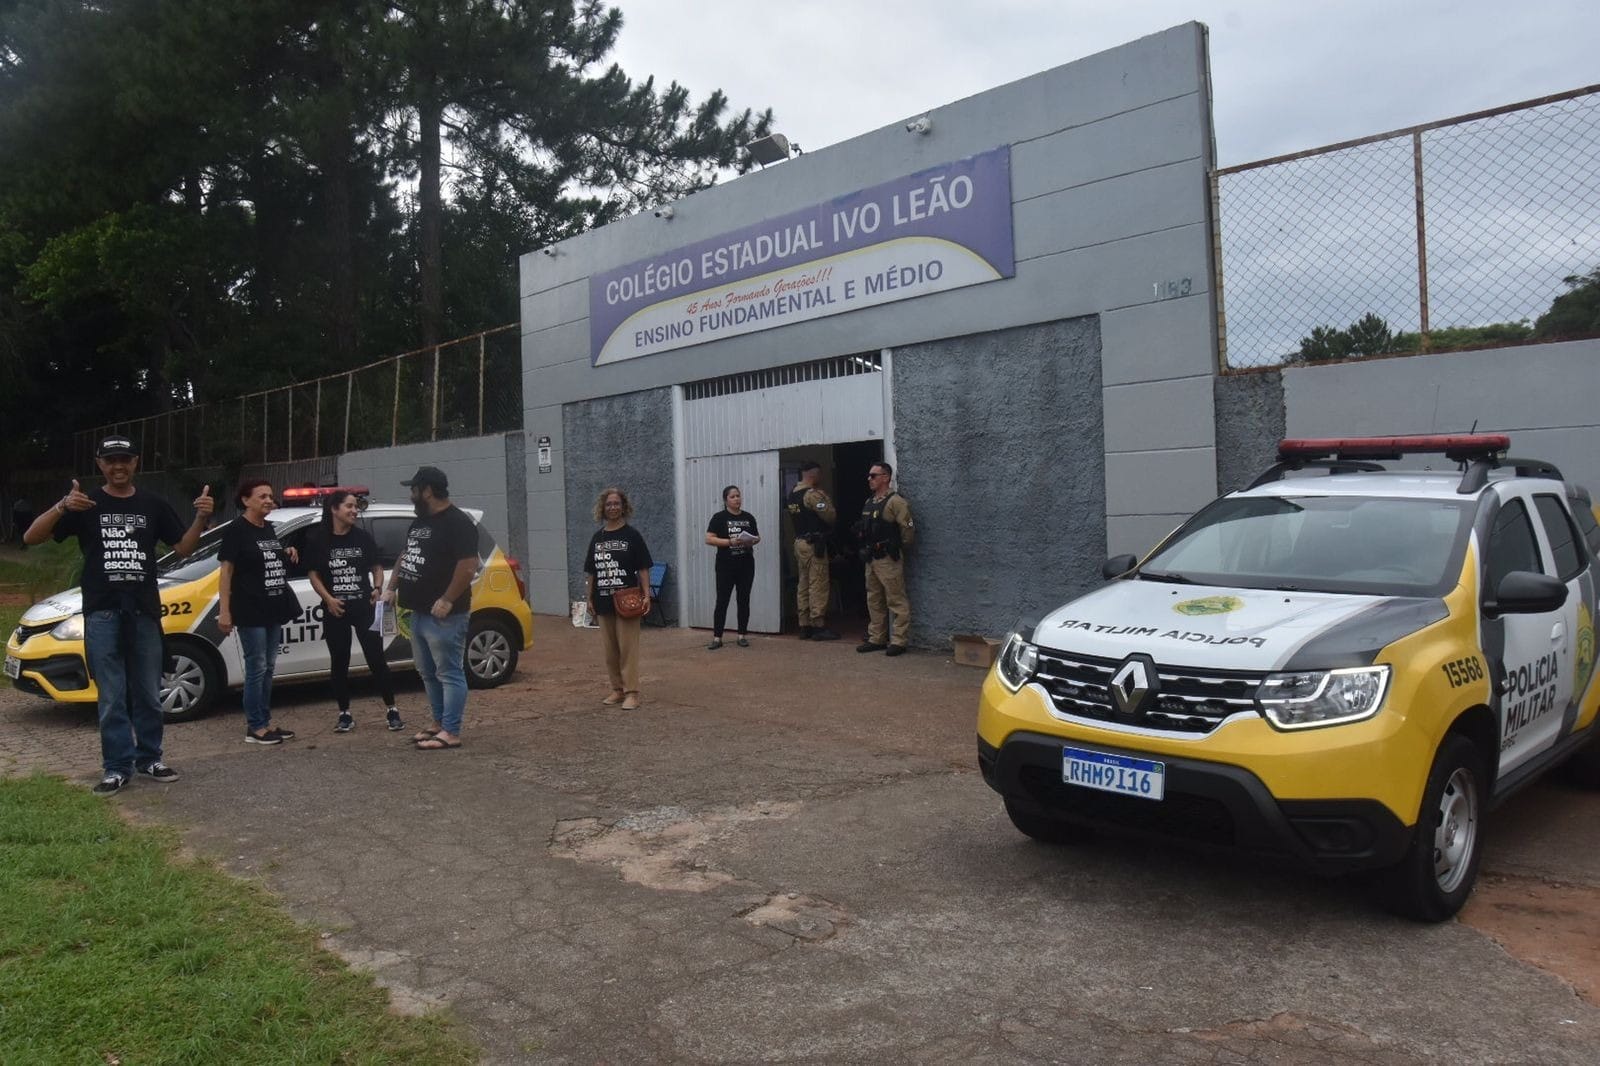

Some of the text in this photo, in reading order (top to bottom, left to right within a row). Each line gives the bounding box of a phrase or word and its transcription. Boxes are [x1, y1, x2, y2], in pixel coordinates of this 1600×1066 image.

[606, 175, 973, 305] COLÉGIO ESTADUAL IVO LEÃO
[635, 260, 943, 347] ENSINO FUNDAMENTAL E MÉDIO
[687, 303, 697, 315] 45
[701, 299, 722, 312] Anos
[724, 285, 771, 308] Formando
[101, 528, 126, 538] Não
[103, 539, 138, 549] venda
[104, 560, 143, 570] escola.
[112, 549, 147, 560] minha
[160, 601, 193, 617] 922
[1442, 656, 1484, 689] 15568
[1504, 684, 1557, 736] MILITAR
[1070, 761, 1151, 794] RHM9I16
